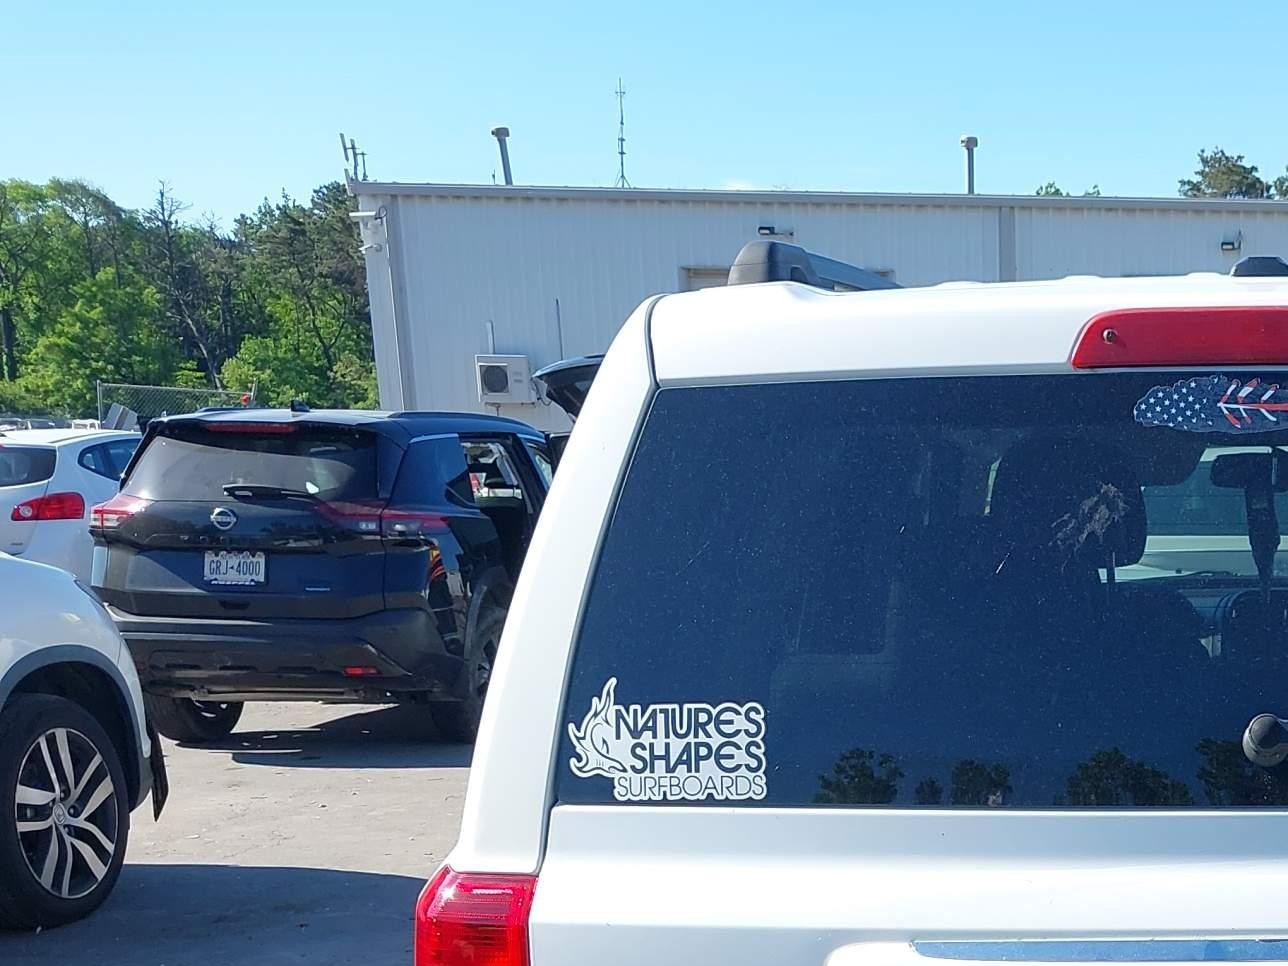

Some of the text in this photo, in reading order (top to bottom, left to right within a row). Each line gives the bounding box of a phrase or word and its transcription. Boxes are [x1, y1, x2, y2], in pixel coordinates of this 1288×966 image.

[615, 706, 762, 740] NATURES
[630, 740, 762, 774] SHAPES
[616, 775, 765, 798] SURFBOARDS
